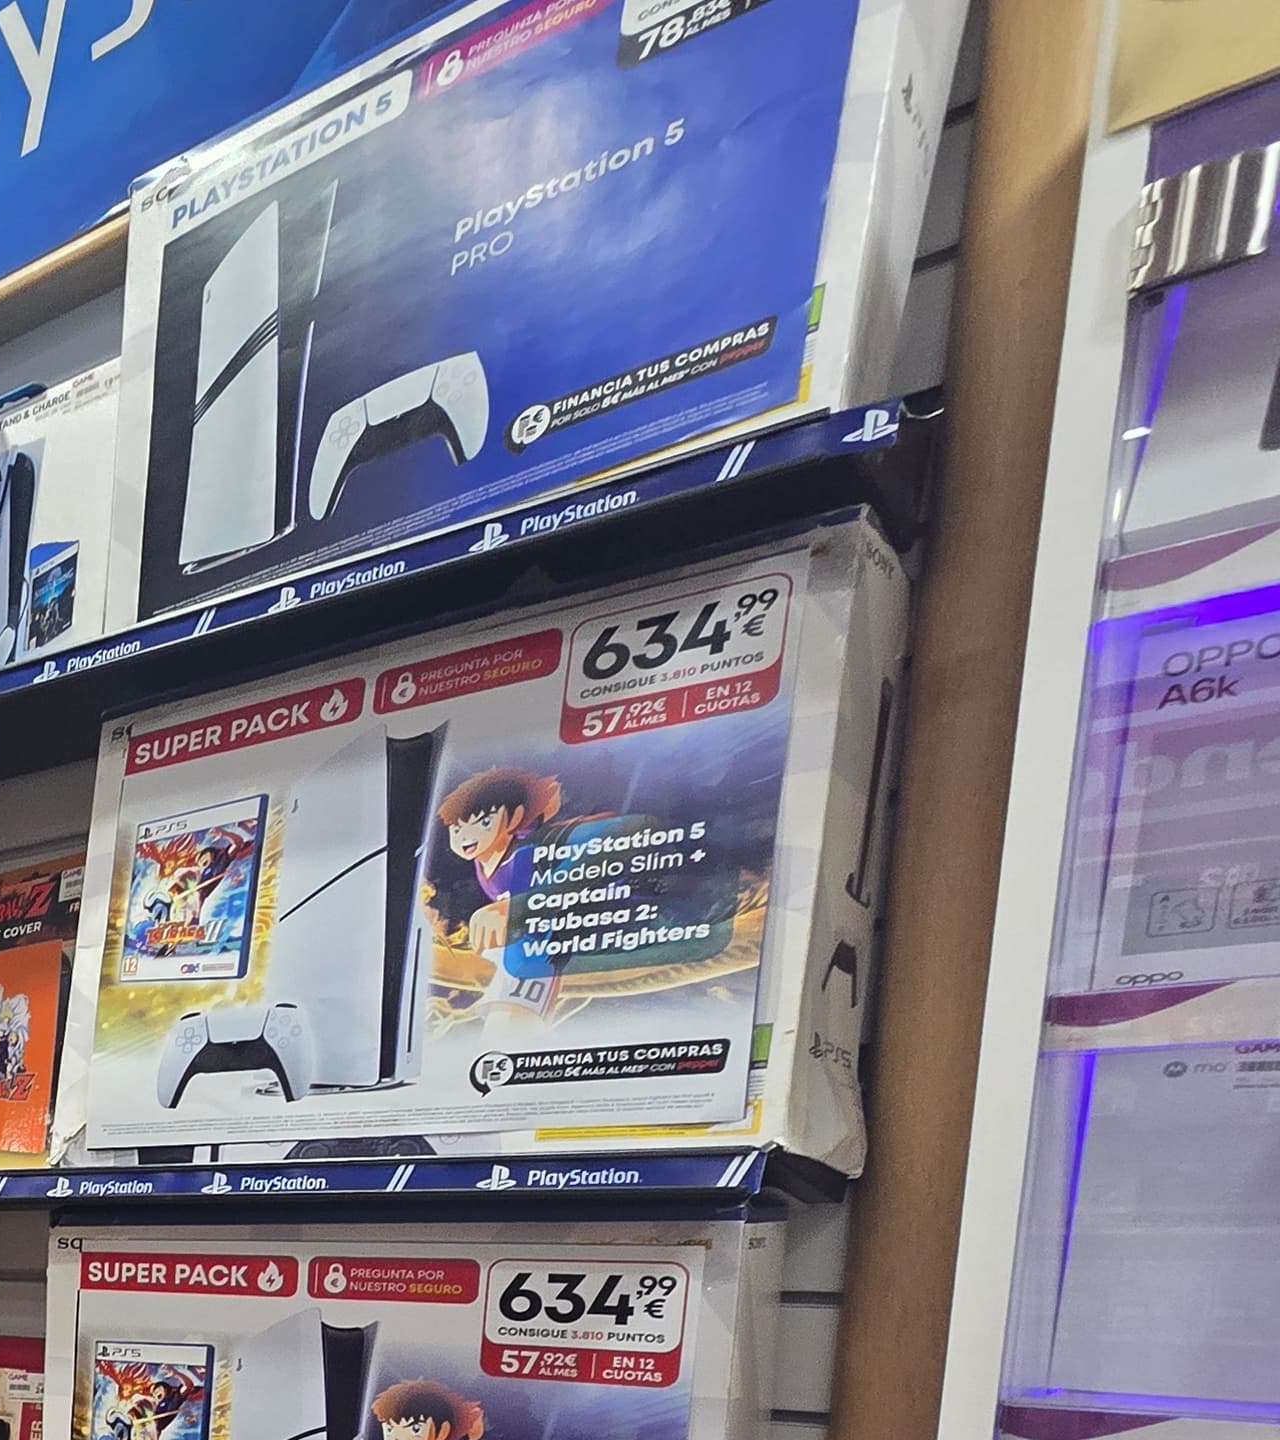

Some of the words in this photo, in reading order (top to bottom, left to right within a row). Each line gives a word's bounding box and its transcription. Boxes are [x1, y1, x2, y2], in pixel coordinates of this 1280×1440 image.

[169, 105, 373, 231] PLAYSTATION
[373, 89, 395, 120] 5
[453, 132, 655, 244] PlayStation
[663, 117, 687, 148] 5
[449, 230, 516, 276] PRO
[552, 375, 633, 414] FINANCIA
[637, 360, 669, 382] TUS
[675, 322, 770, 368] COMPRAS
[520, 487, 639, 537] PlayStation
[309, 558, 406, 601] PlayStation
[490, 646, 523, 666] POR
[417, 673, 480, 698] NUESTRO
[481, 658, 543, 684] SEGURO
[580, 675, 657, 699] CONSIGUE
[699, 651, 765, 675] PUNTOS
[705, 686, 730, 700] EN
[732, 679, 753, 693] 12
[694, 693, 761, 714] CUOTAS
[1158, 676, 1242, 710] A6k
[133, 723, 223, 765] SUPER
[229, 700, 310, 743] PACK
[531, 827, 684, 865] PlayStation
[686, 821, 706, 841] 5
[528, 859, 626, 887] Modelo
[628, 850, 684, 873] Slim
[688, 847, 707, 863] +
[23, 881, 55, 919] Z
[527, 881, 632, 912] Captain
[3, 922, 42, 940] COVER
[524, 907, 623, 933] Tsubasa
[628, 902, 659, 922] 2:
[522, 931, 596, 957] World
[600, 919, 711, 953] Fighters
[1116, 971, 1184, 986] oppo
[516, 1053, 593, 1068] FINANCIA
[597, 1050, 630, 1063] TUS
[634, 1044, 723, 1060] COMPRAS
[514, 1071, 535, 1080] POR
[536, 1069, 563, 1079] SOLO
[581, 1065, 605, 1076] MÁS
[606, 1066, 620, 1074] AL
[650, 1062, 676, 1073] CON
[79, 1178, 154, 1197] PlayStation
[240, 1172, 329, 1193] PlayStation
[527, 1166, 641, 1188] PlayStation
[87, 1260, 168, 1285] SUPER
[174, 1262, 249, 1287] PACK
[351, 1268, 415, 1281] PREGUNTA
[417, 1270, 445, 1280] POR
[350, 1282, 406, 1294] NUESTRO
[408, 1283, 463, 1295] SEGURO
[498, 1326, 568, 1339] CONSIGUE
[571, 1330, 604, 1340] 3.810
[607, 1332, 666, 1343] PUNTOS
[602, 1369, 663, 1383] CUOTAS
[612, 1356, 635, 1369] EN
[638, 1358, 656, 1369] 12
